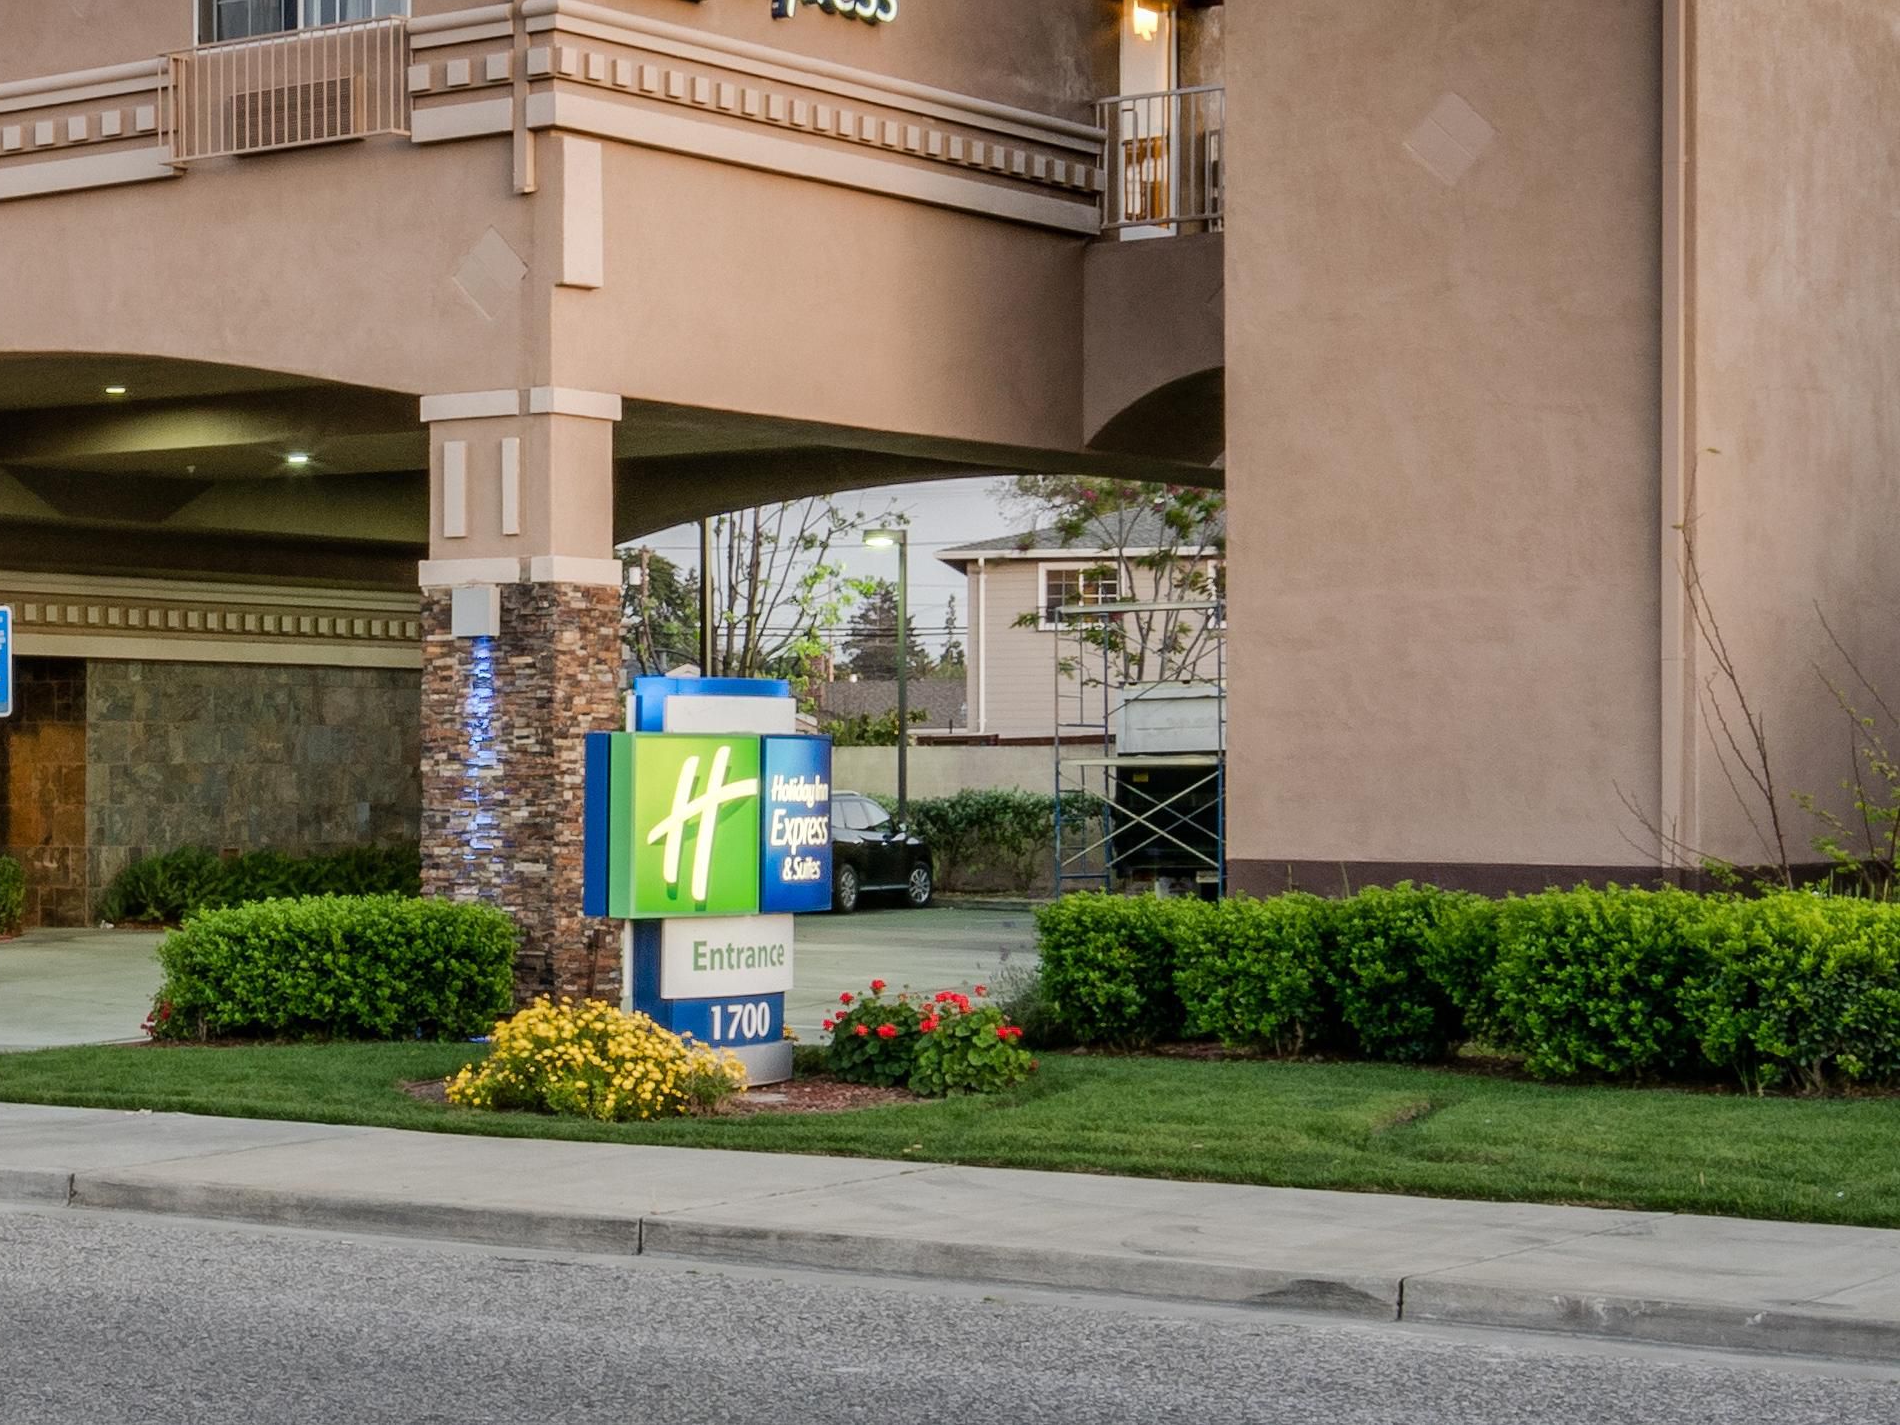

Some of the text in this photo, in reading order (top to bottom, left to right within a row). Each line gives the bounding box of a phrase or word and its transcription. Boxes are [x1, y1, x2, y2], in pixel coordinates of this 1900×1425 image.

[771, 774, 815, 808] Holiday
[770, 808, 829, 855] Express
[793, 856, 821, 881] Suites
[692, 940, 785, 971] Entrance
[710, 1001, 771, 1041] 1700
